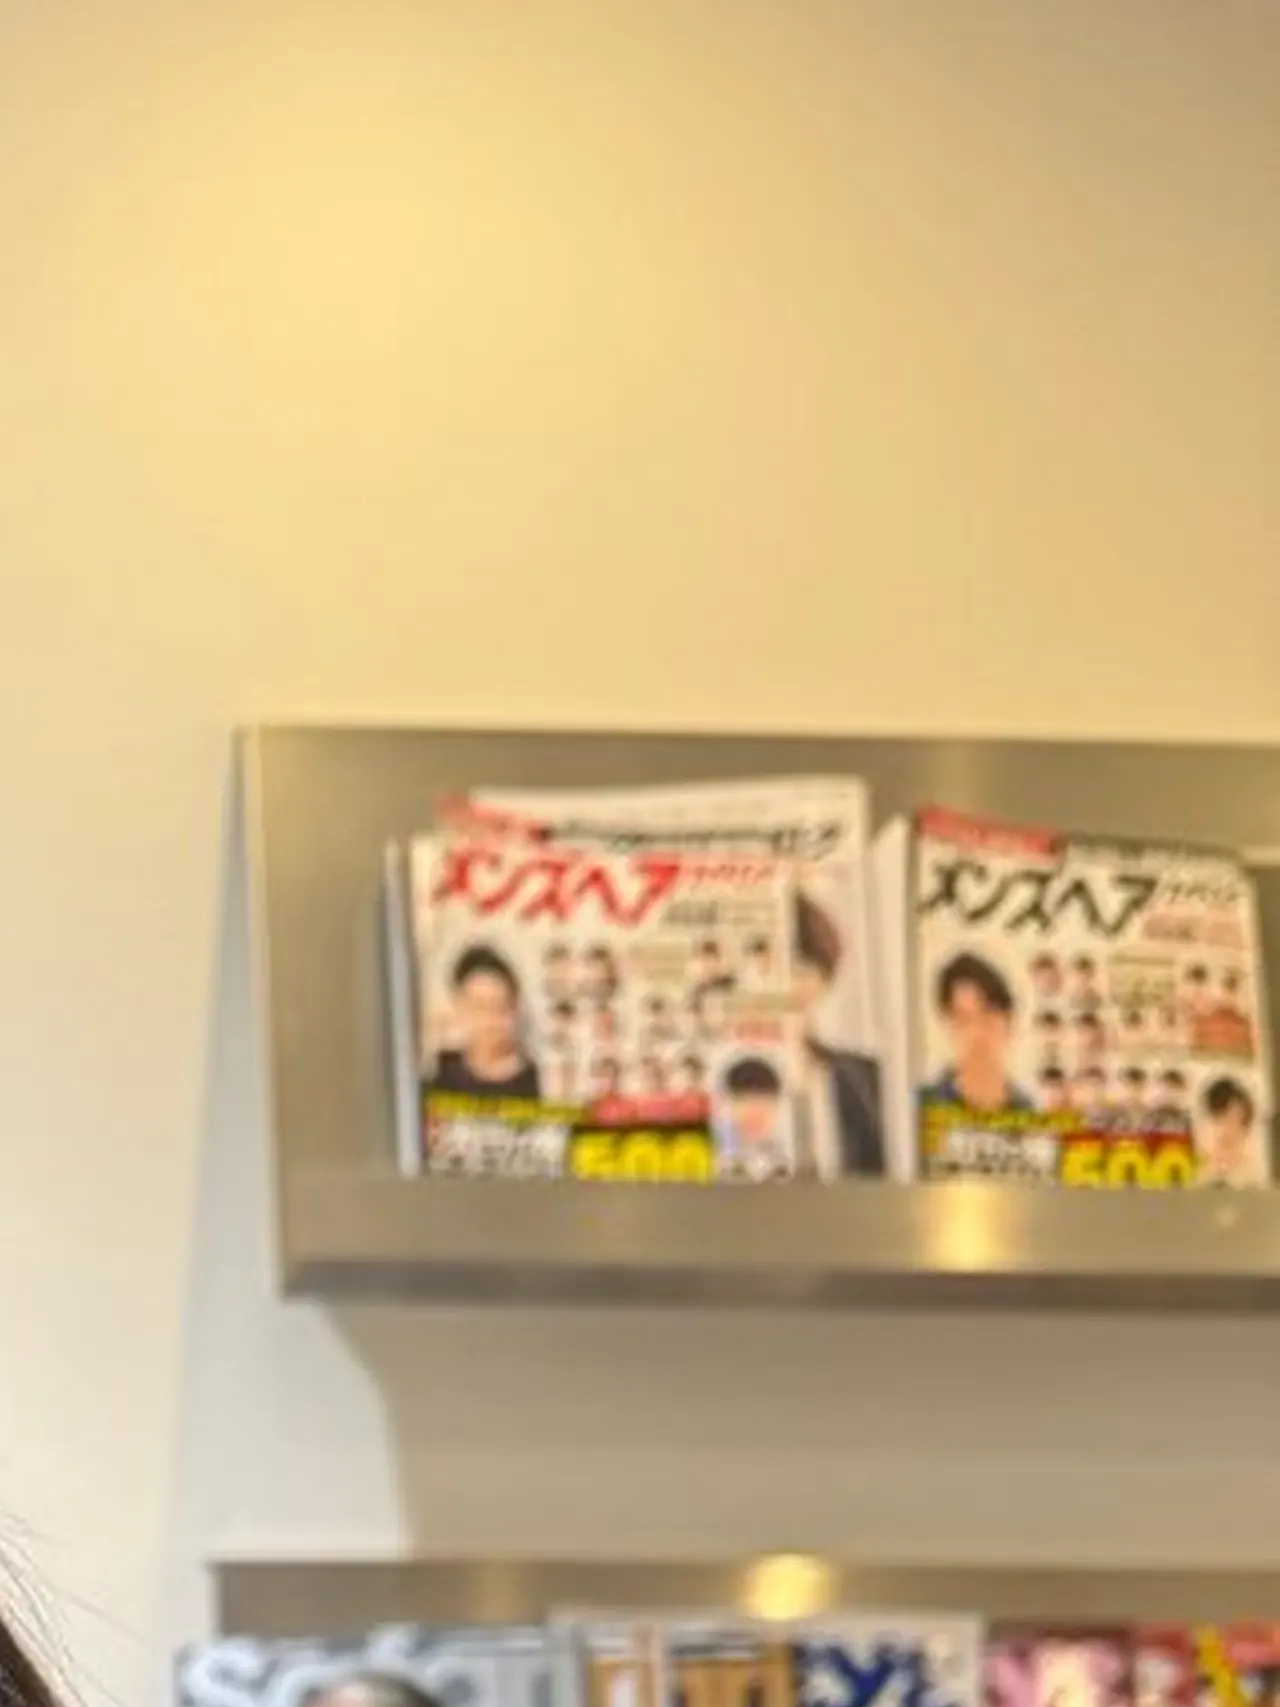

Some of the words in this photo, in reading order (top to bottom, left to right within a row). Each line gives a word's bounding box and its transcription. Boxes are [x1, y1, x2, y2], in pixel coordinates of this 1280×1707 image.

[916, 860, 1158, 936] メンズヘア
